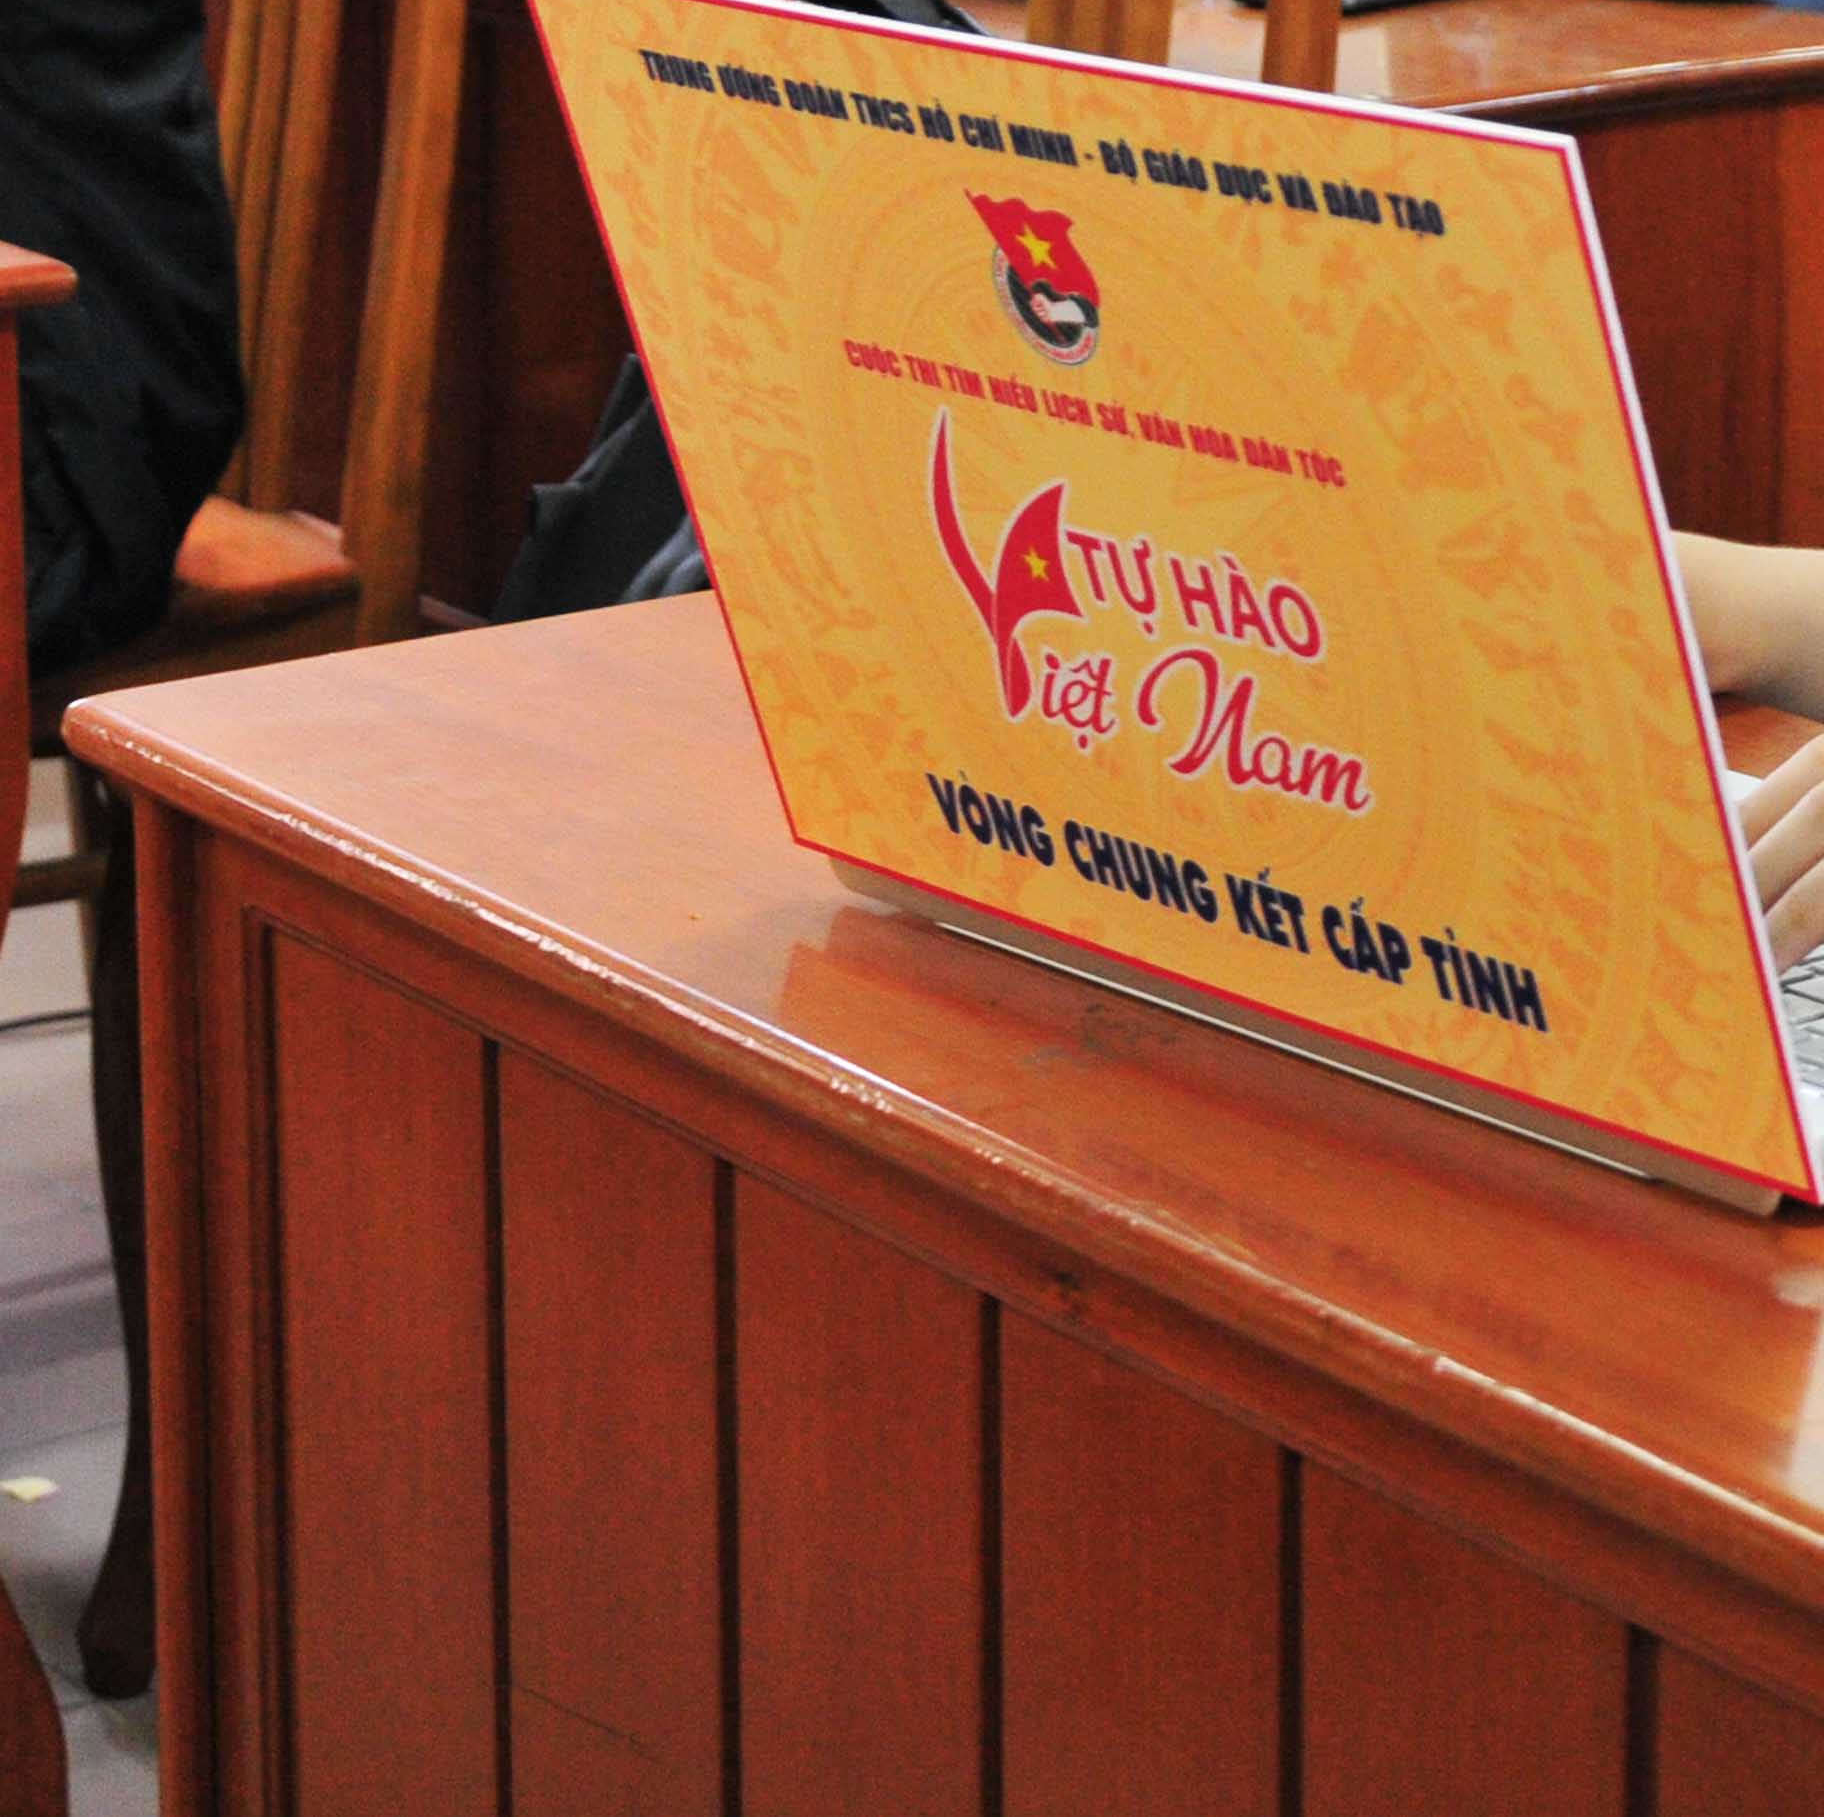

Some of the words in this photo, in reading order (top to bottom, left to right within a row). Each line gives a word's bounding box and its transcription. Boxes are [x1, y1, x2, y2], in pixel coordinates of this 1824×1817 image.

[638, 49, 715, 93] TRUNG
[1008, 122, 1079, 167] MINH
[1212, 161, 1273, 206] DỤC
[1276, 170, 1319, 212] VÀ
[903, 354, 942, 389] THI
[1295, 448, 1347, 488] TỘC
[1065, 528, 1159, 635] TỰ
[1169, 555, 1323, 659] HÀO
[1136, 648, 1370, 813] Nam
[925, 770, 1056, 867] VÒNG
[1063, 819, 1218, 923] CHUNG
[1224, 867, 1311, 955] KẾT
[1322, 896, 1412, 985] CẤP
